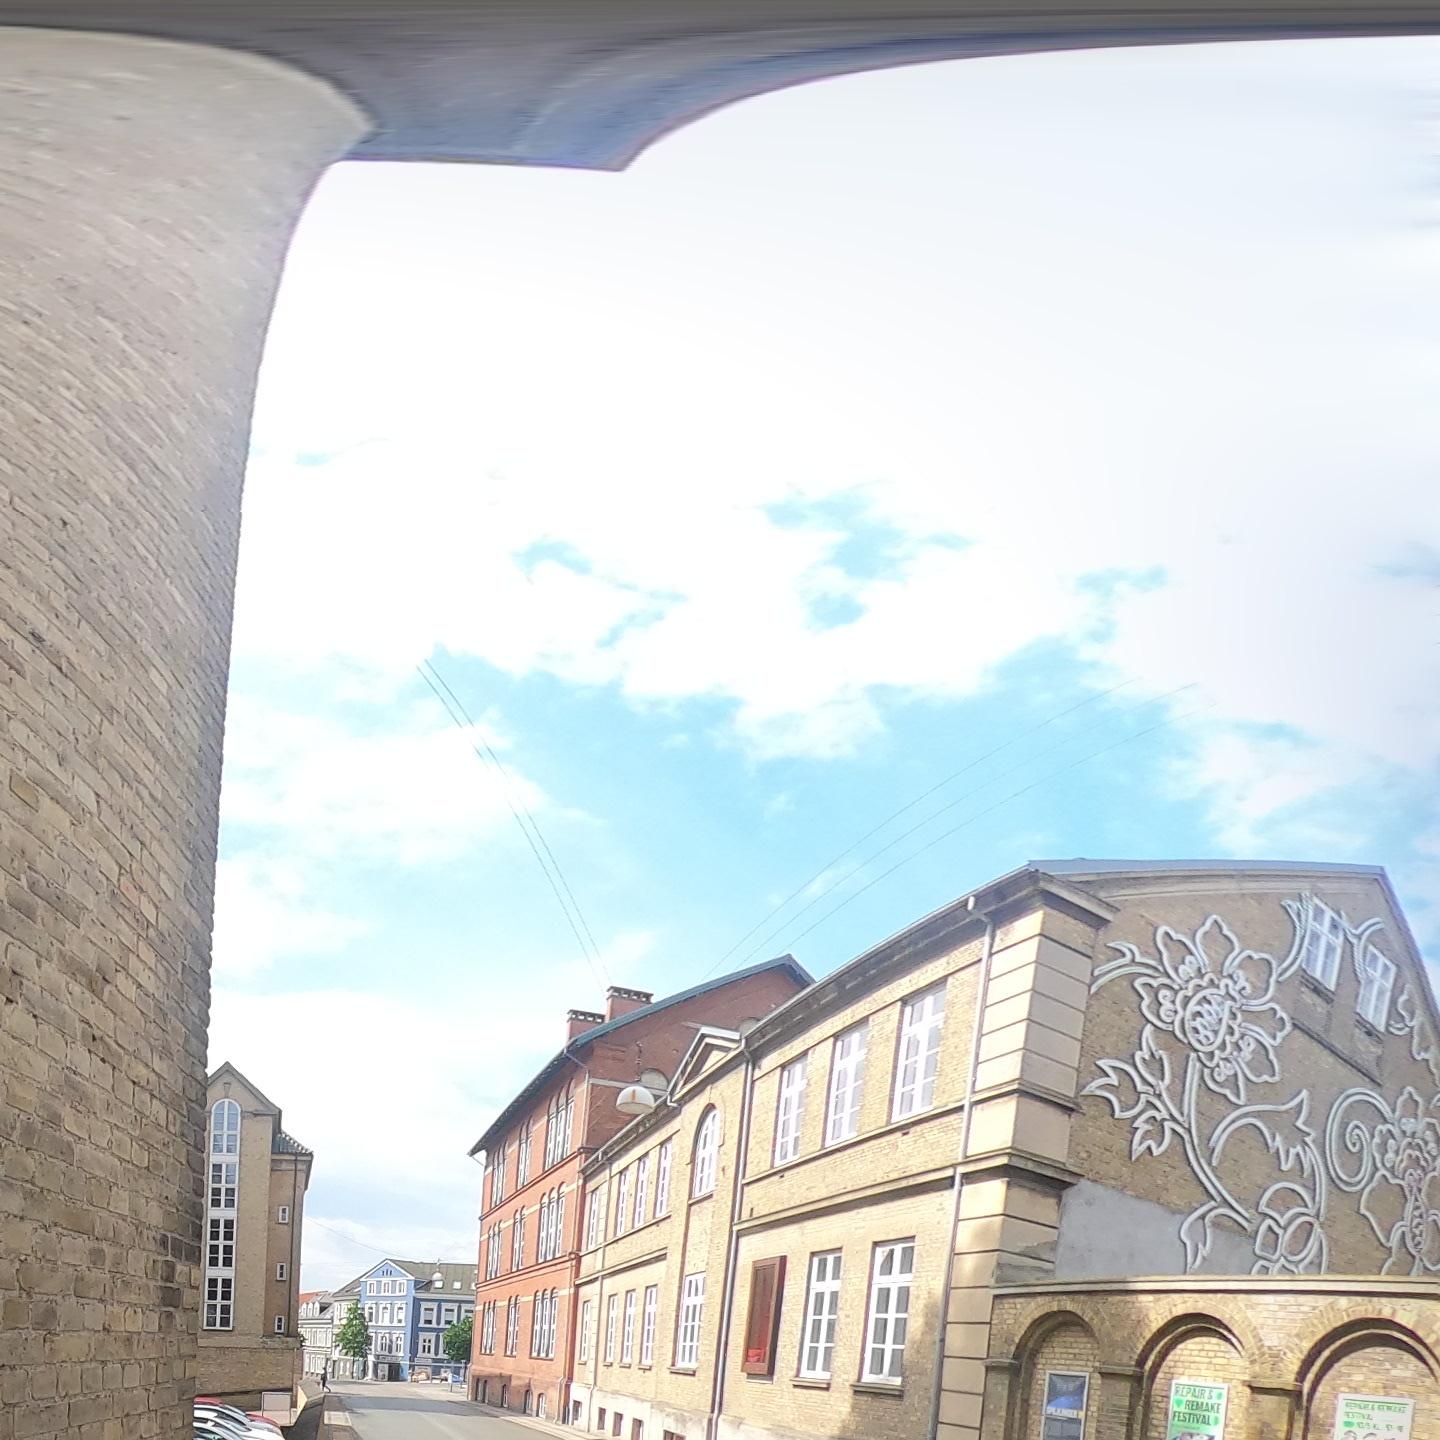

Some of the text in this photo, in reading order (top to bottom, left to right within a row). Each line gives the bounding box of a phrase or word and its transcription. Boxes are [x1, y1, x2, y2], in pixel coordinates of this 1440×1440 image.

[1174, 1385, 1206, 1399] REPAIR
[1185, 1400, 1222, 1414] REMAKE
[1173, 1411, 1212, 1426] FESTIVAL
